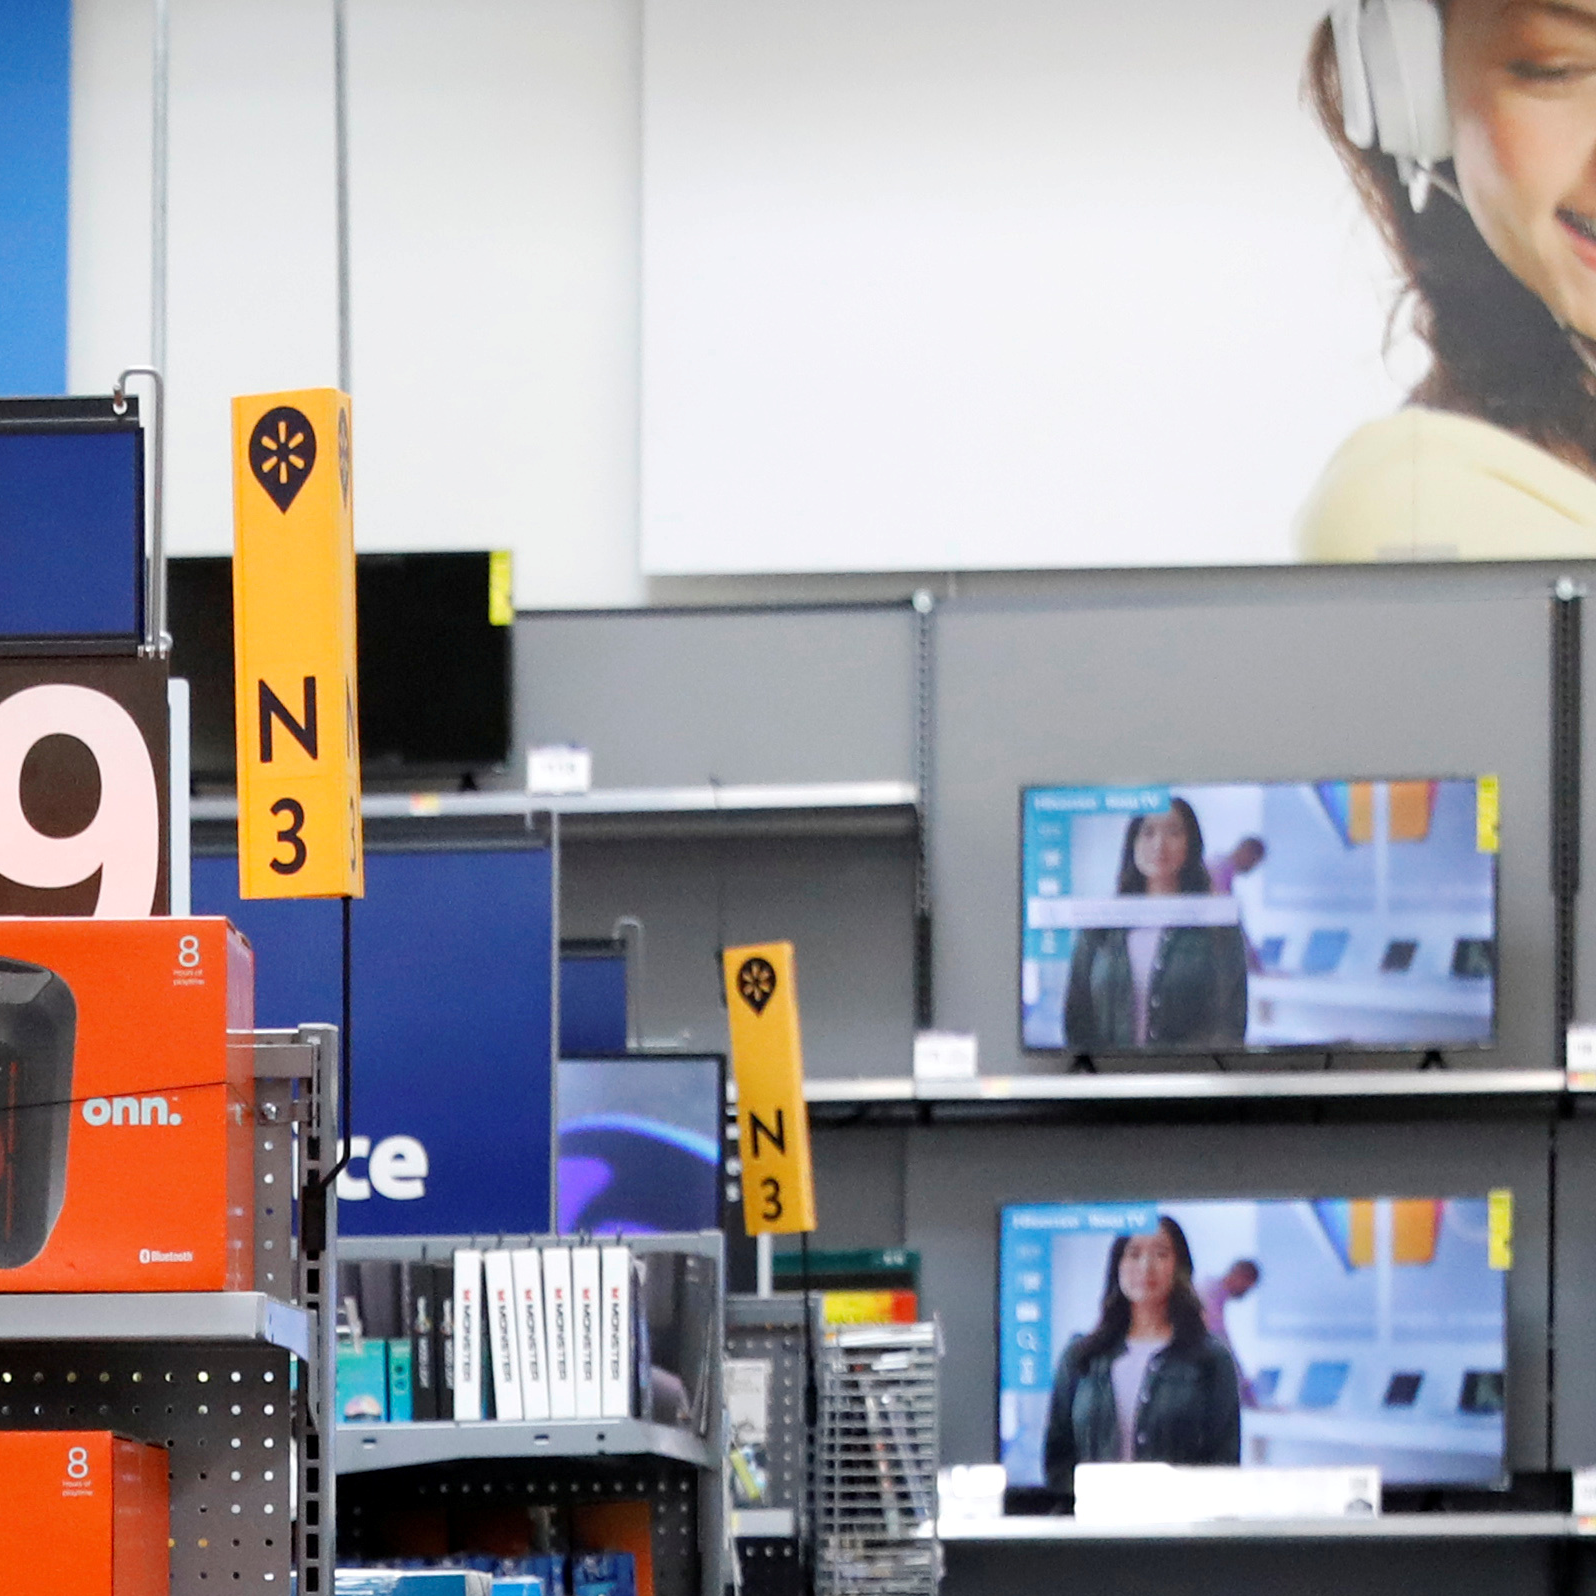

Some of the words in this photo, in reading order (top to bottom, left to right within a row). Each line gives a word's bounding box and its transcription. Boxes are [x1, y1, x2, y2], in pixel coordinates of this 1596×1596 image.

[258, 675, 319, 763] N
[269, 796, 307, 875] 3
[178, 935, 200, 968] 8
[82, 1096, 182, 1126] onn.
[749, 1108, 787, 1158] N
[761, 1177, 783, 1221] 3
[463, 1305, 472, 1382] MONSTER
[498, 1305, 511, 1383] MONSTER
[526, 1304, 538, 1382] MONSTER
[555, 1303, 566, 1381] MONSTER
[582, 1303, 592, 1382] MONSTER
[610, 1302, 620, 1382] MONSTER
[66, 1447, 88, 1478] 8
